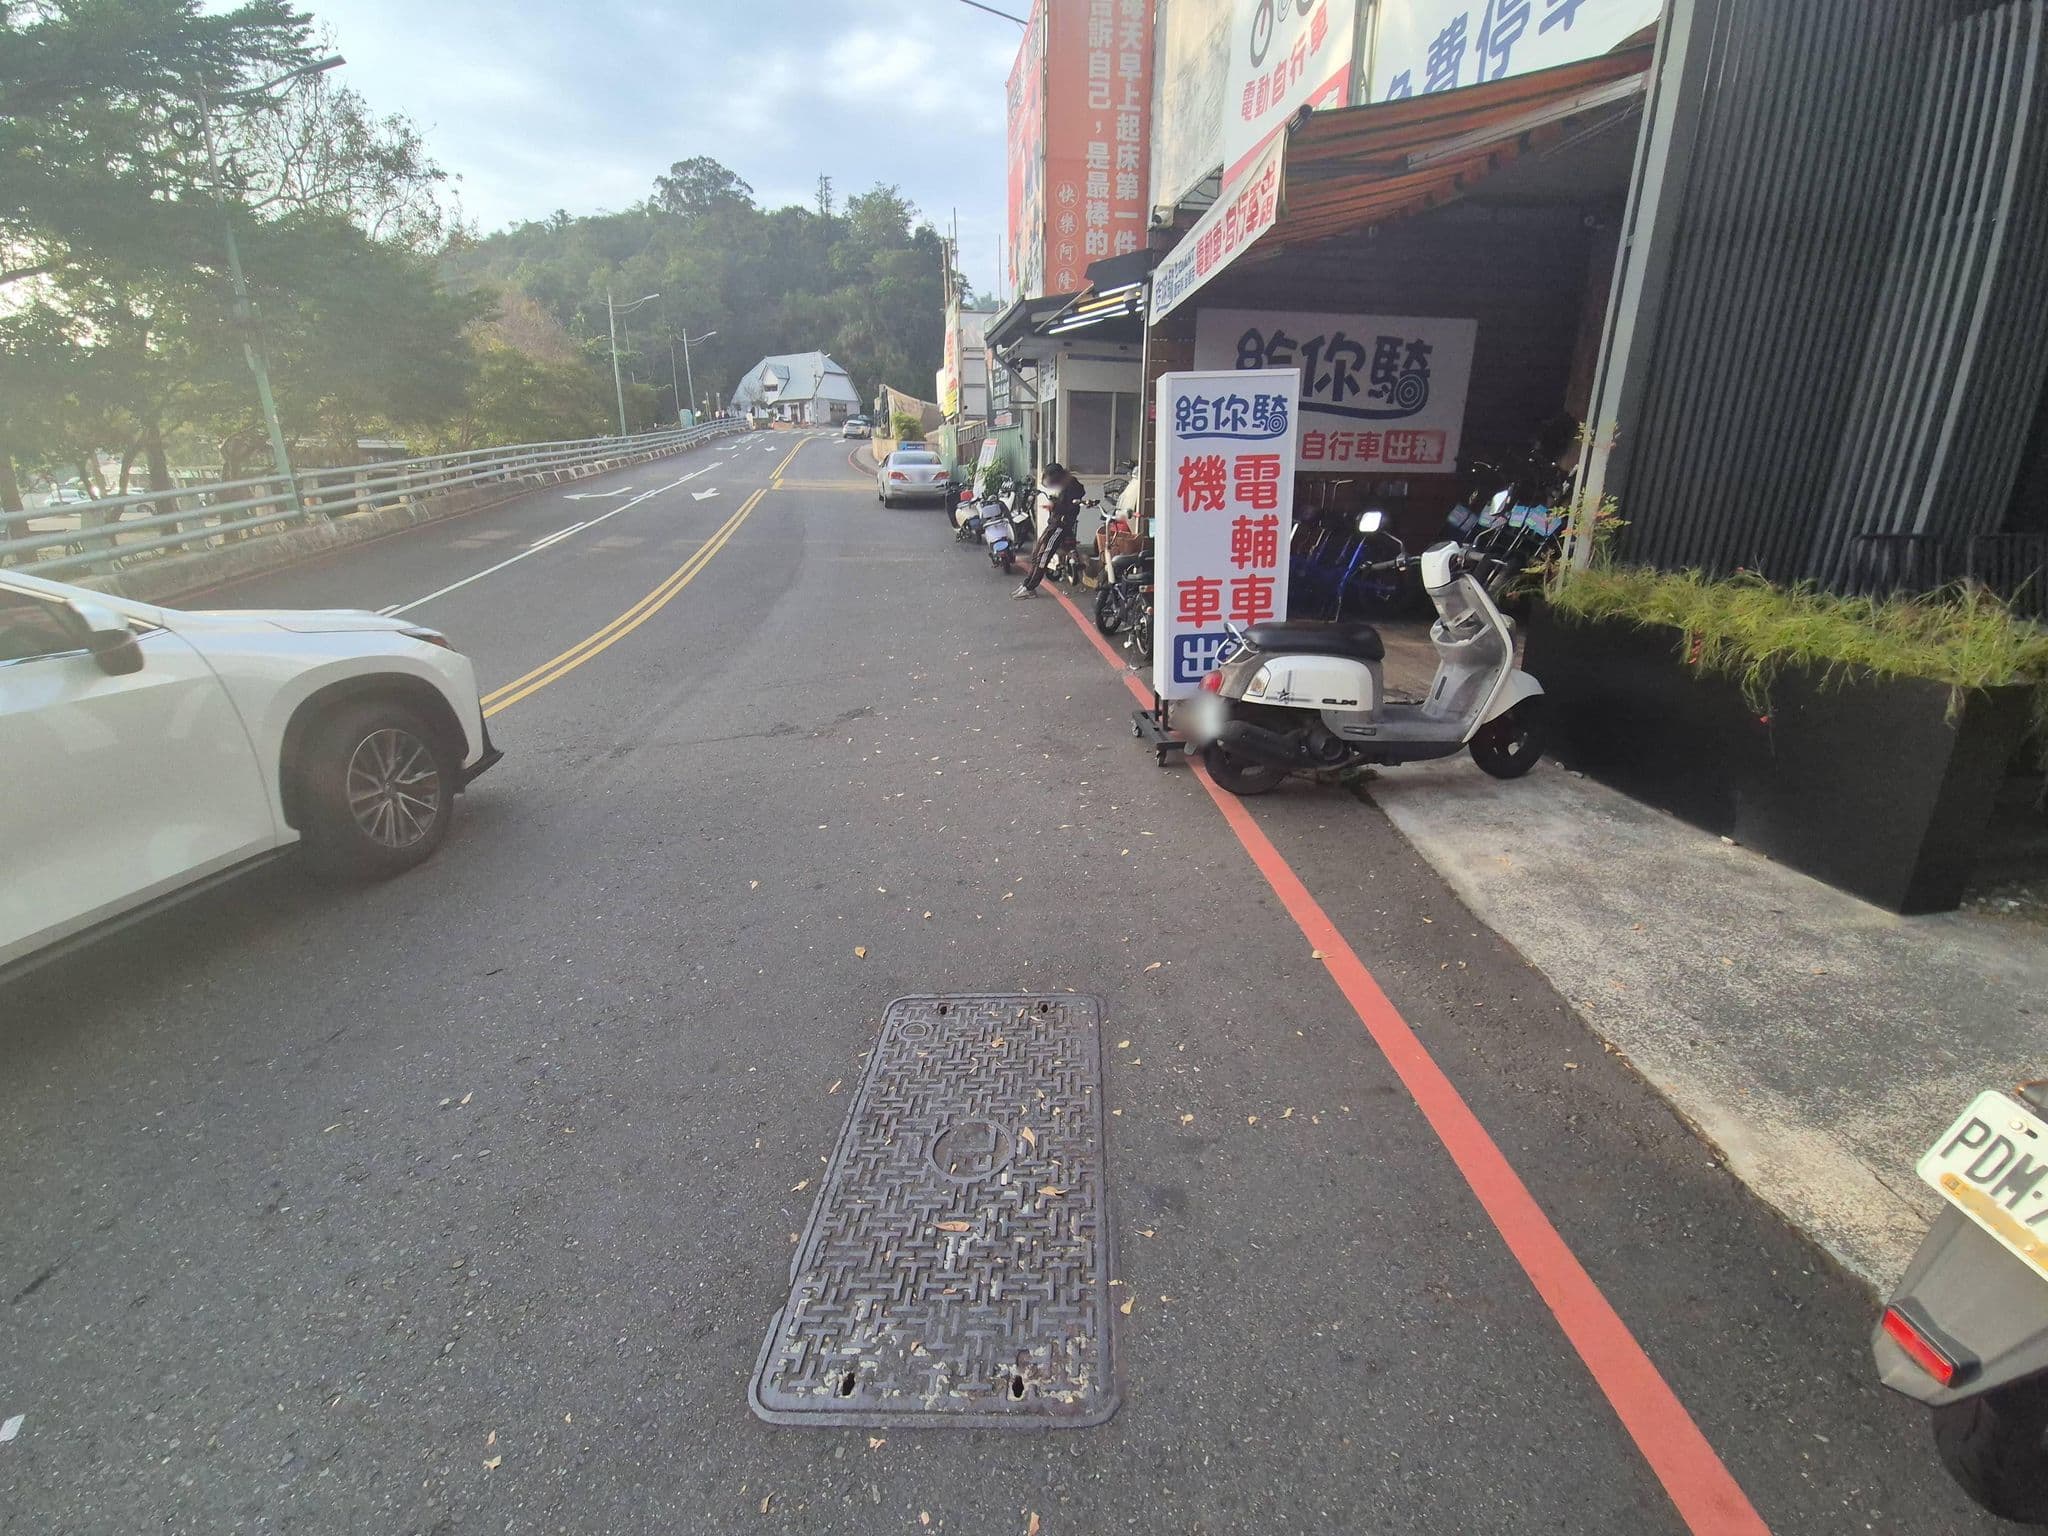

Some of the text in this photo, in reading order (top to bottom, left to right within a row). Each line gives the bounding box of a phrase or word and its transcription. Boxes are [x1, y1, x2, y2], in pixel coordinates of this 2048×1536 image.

[1175, 393, 1289, 437] 給你騎
[1180, 636, 1237, 678] 出
